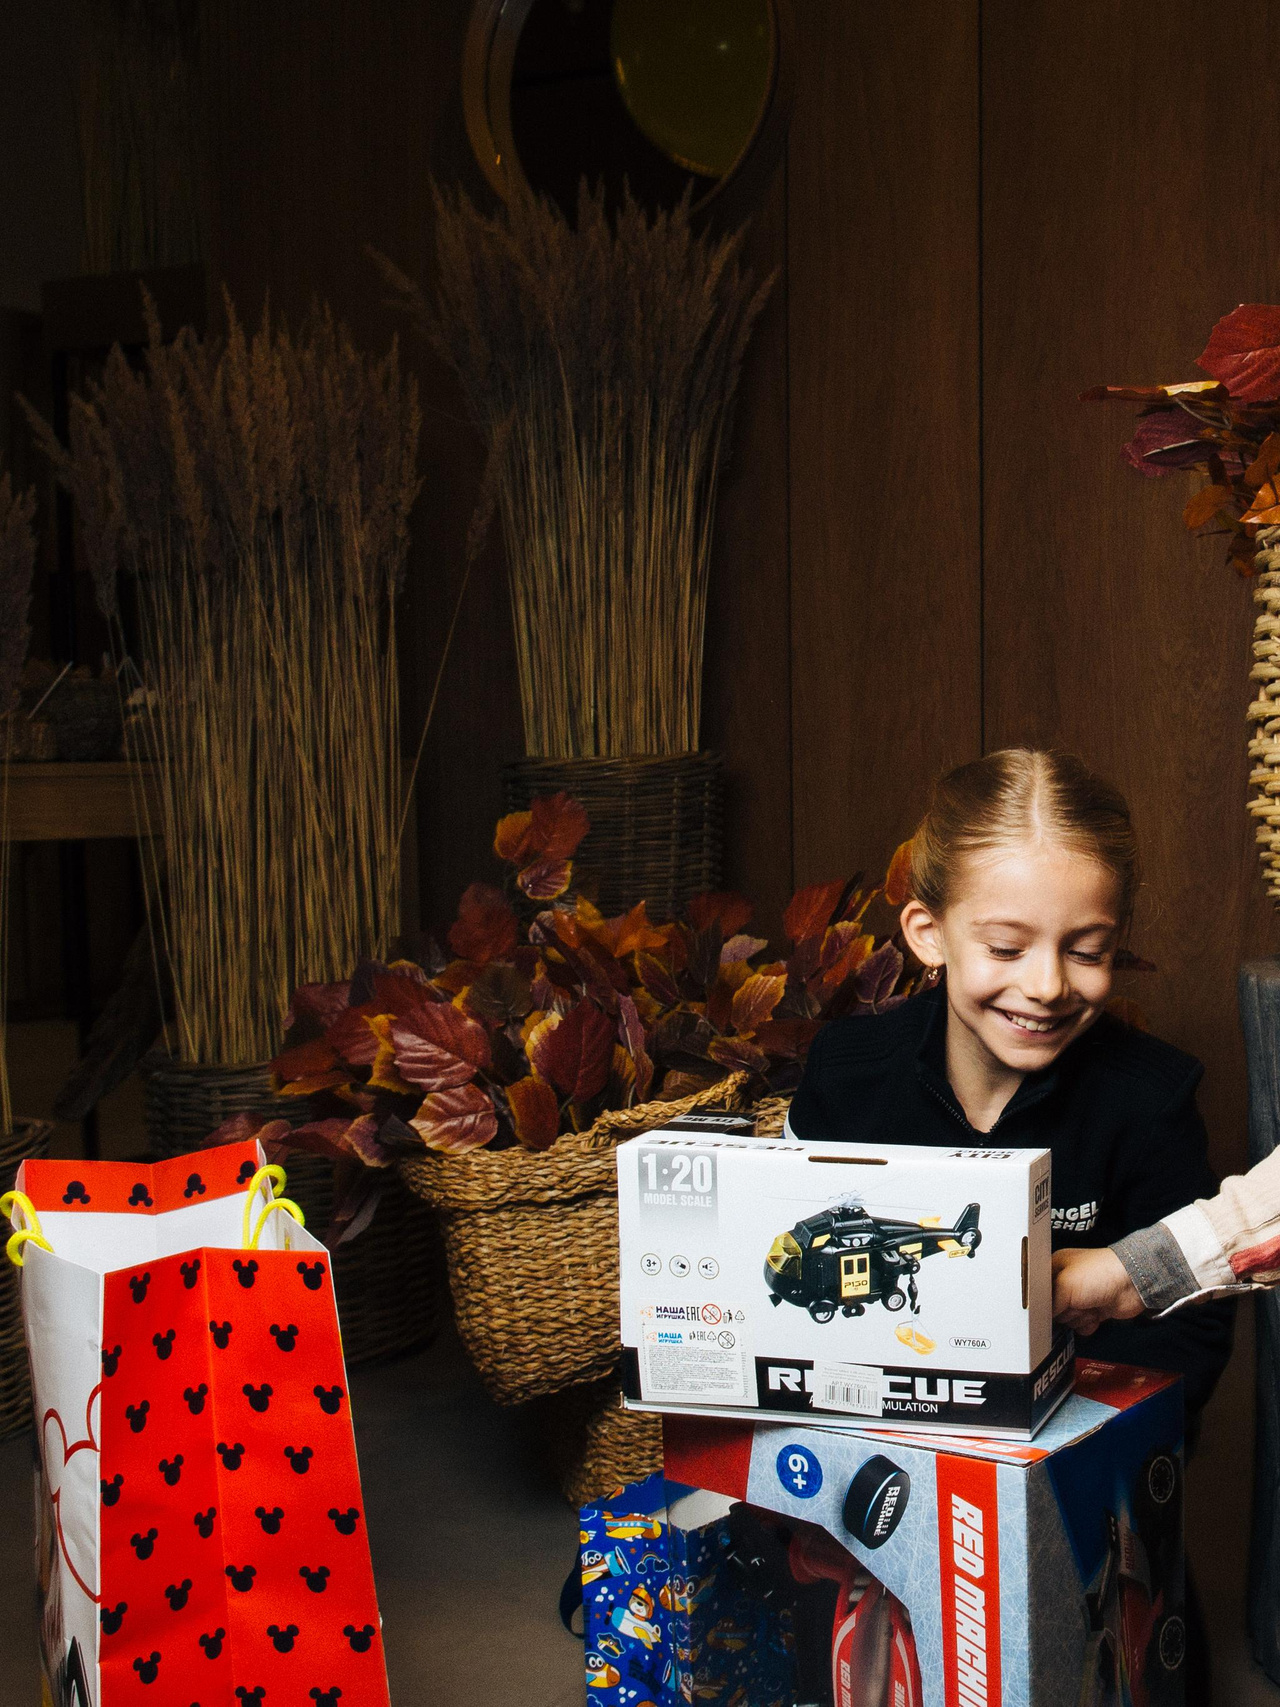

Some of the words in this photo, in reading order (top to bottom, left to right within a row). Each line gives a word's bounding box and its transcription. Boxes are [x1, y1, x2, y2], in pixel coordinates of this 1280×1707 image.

[948, 1152, 1012, 1160] CITY
[642, 1153, 713, 1193] 1:20
[643, 1192, 678, 1206] MODEL
[680, 1194, 713, 1208] SCALE
[1034, 1176, 1050, 1205] CITY
[1051, 1200, 1100, 1221] NGEL
[646, 1259, 657, 1268] 3+
[656, 1306, 685, 1314] НАША
[954, 1338, 987, 1348] WY760A
[1034, 1335, 1075, 1402] RESCUE
[768, 1366, 987, 1405] RCUE
[882, 1400, 939, 1413] MULATION
[788, 1453, 809, 1490] 6+
[885, 1485, 901, 1518] RED
[951, 1493, 985, 1579] RED
